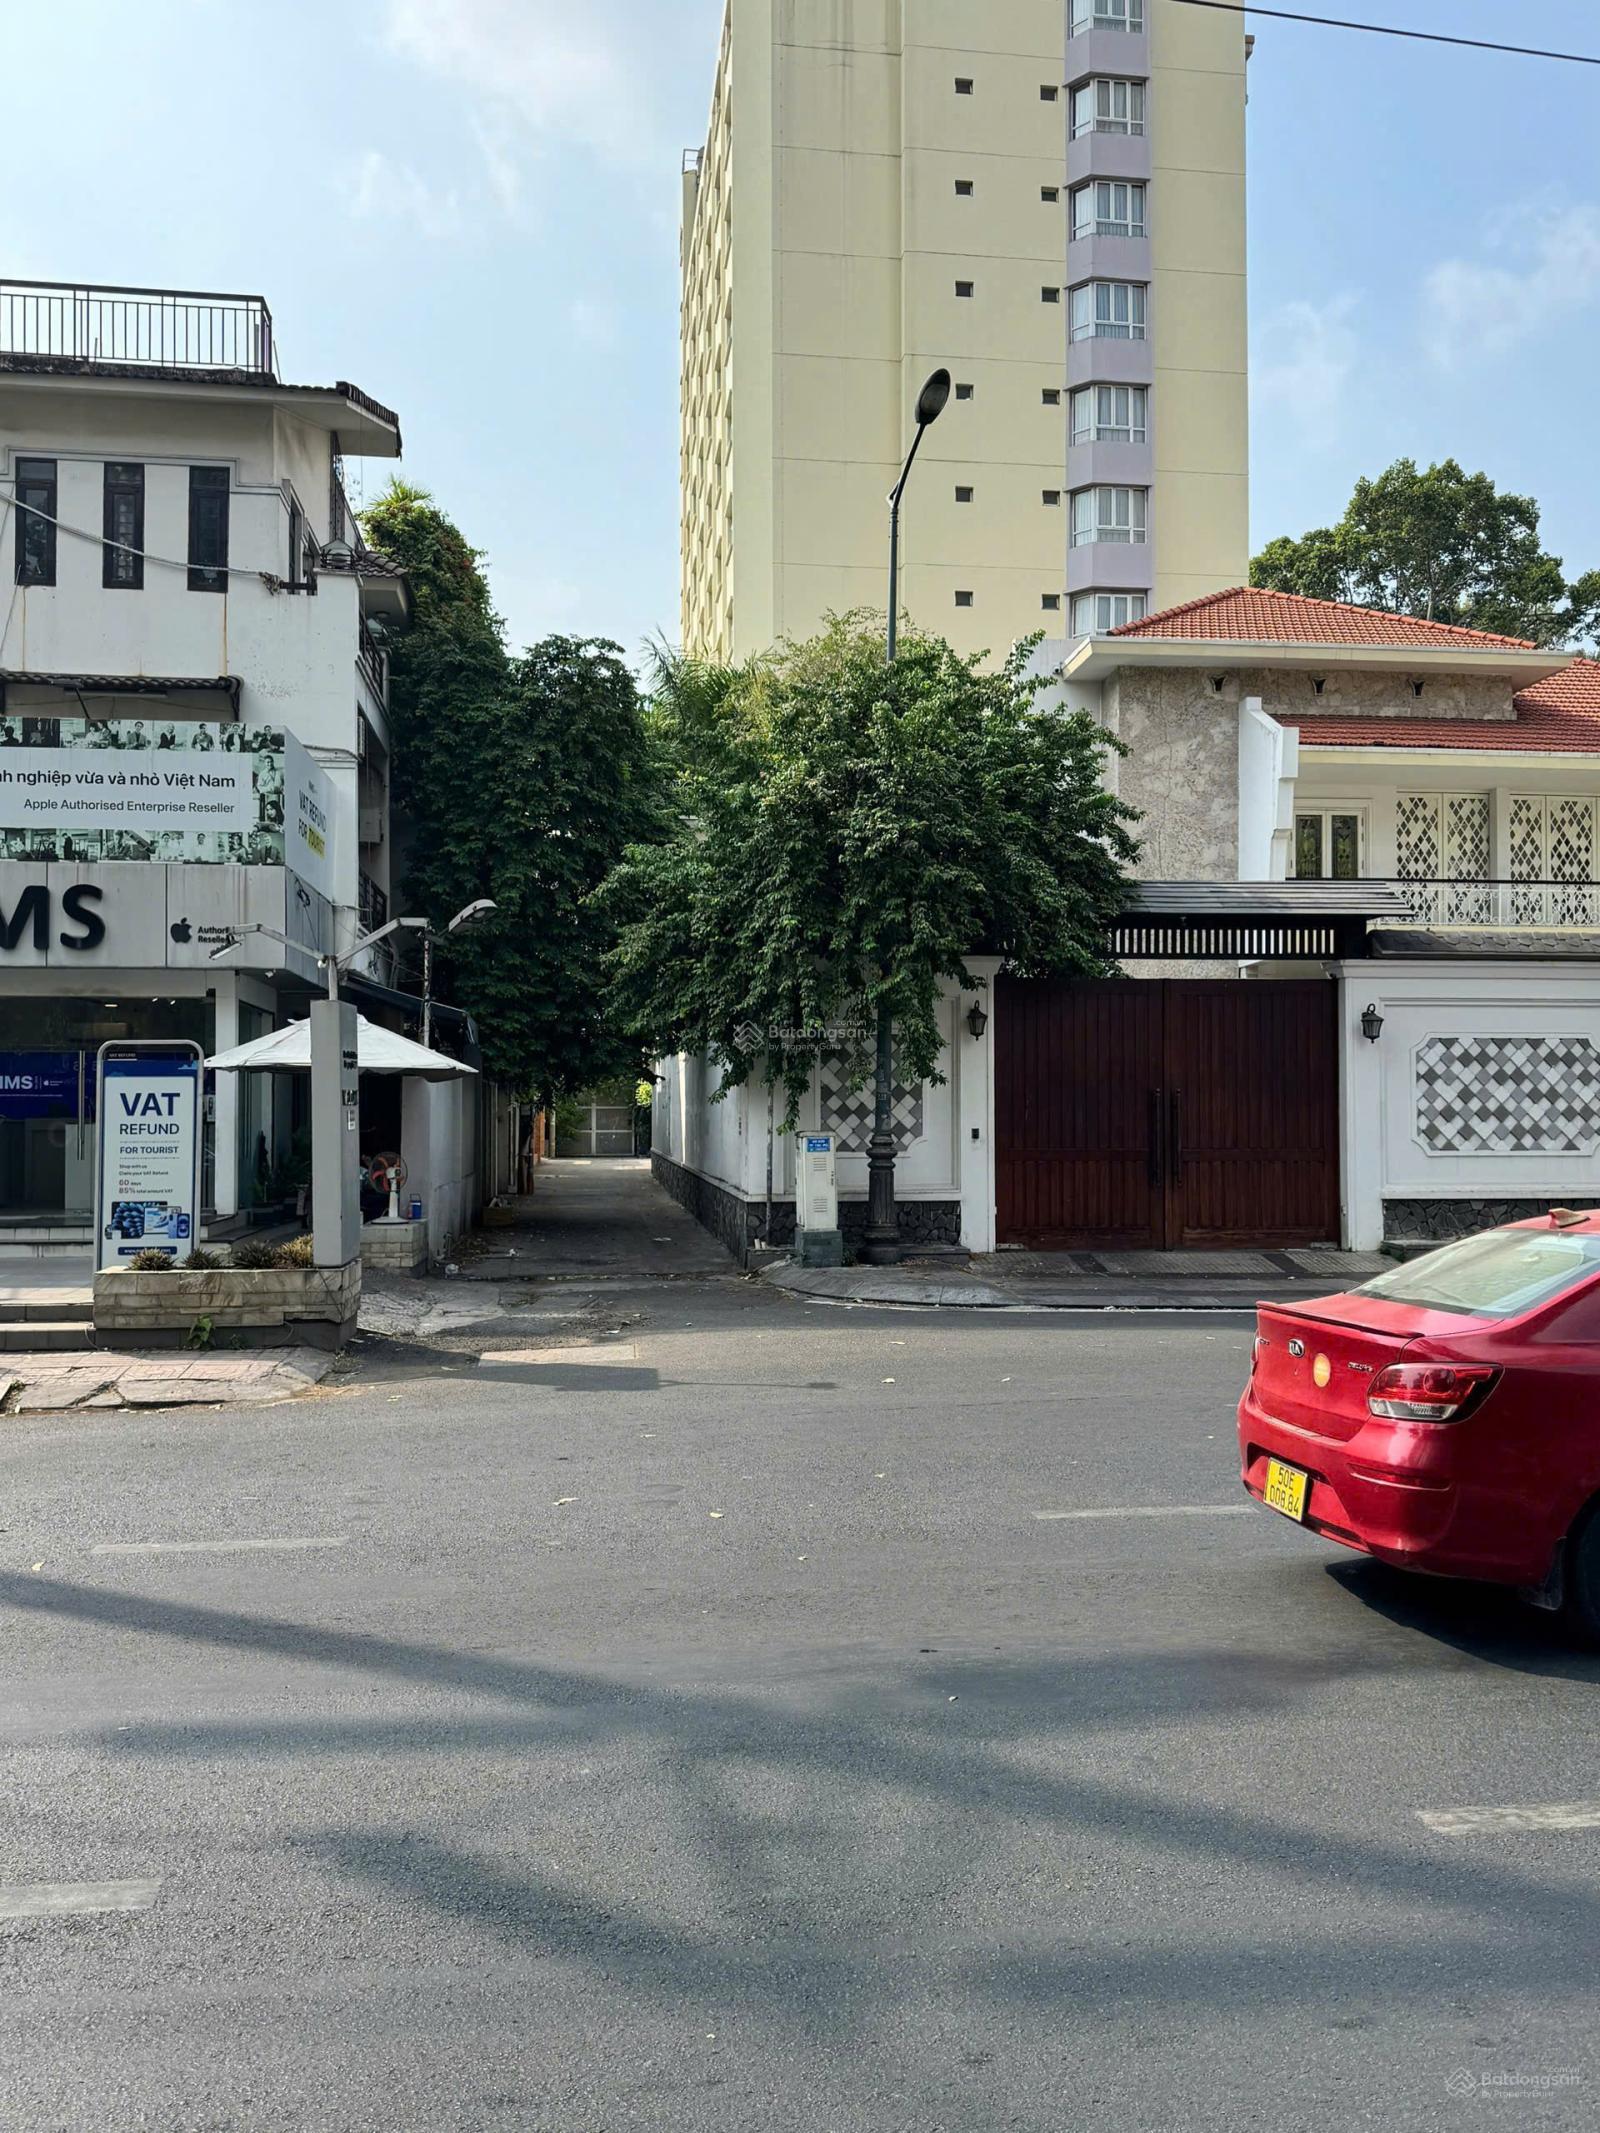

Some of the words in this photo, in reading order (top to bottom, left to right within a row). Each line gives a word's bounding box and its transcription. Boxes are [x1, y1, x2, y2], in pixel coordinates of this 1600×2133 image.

[0, 769, 13, 783] h
[16, 769, 72, 787] nghiệp
[75, 770, 104, 785] vừa
[107, 771, 126, 785] và
[163, 773, 195, 790] Việt
[199, 774, 236, 788] Nam
[23, 798, 58, 811] Apple
[60, 799, 125, 811] Authorised
[127, 801, 186, 814] Enterprise
[188, 802, 235, 813] Reseller
[119, 1092, 181, 1117] VAT
[119, 1123, 180, 1135] REFUND
[119, 1146, 139, 1154] FOR
[140, 1146, 179, 1154] TOURIST
